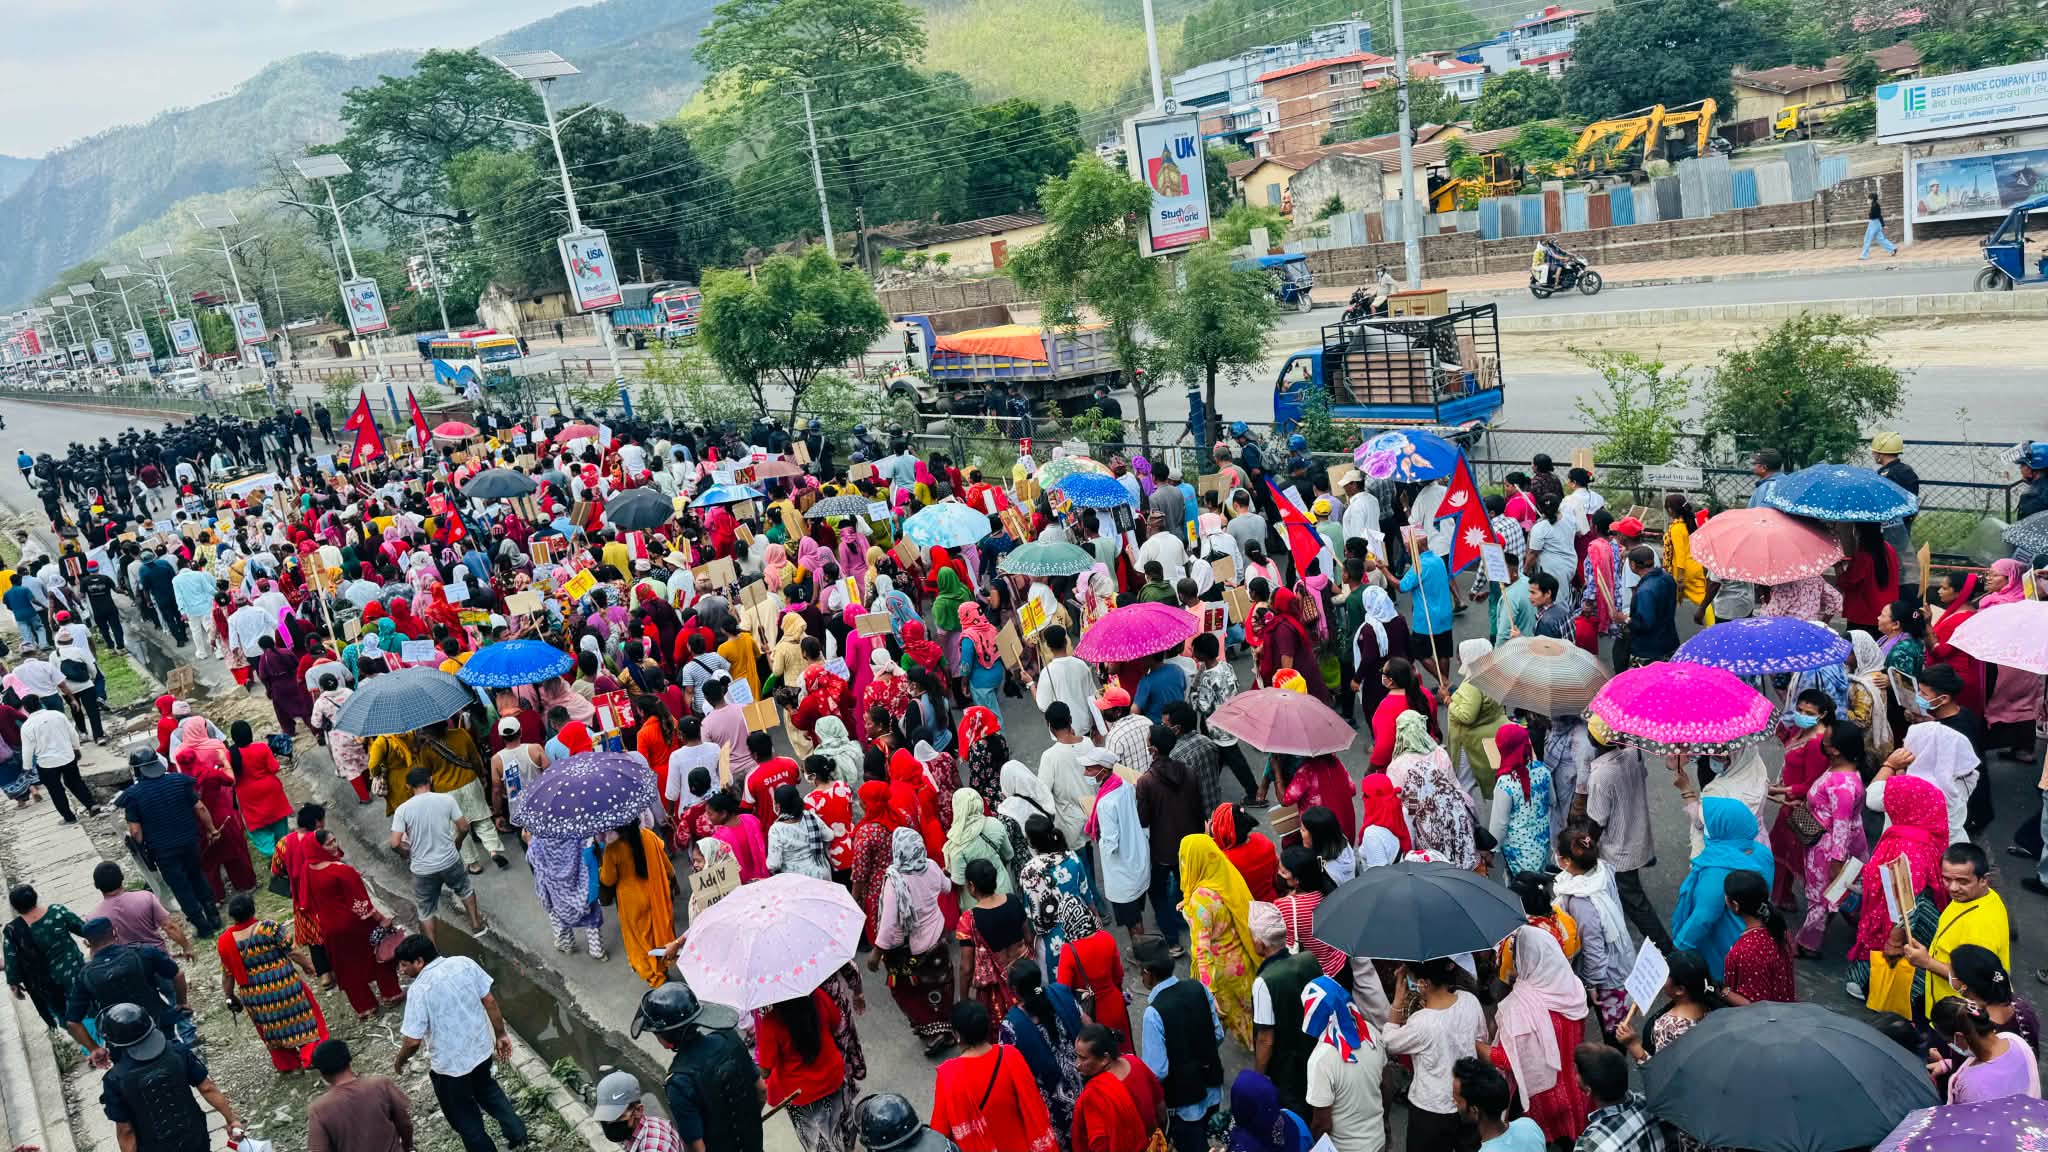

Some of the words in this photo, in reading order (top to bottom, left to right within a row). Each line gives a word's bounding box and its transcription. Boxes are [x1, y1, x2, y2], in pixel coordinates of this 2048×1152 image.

[1931, 87, 1951, 98] BEST
[1953, 81, 1988, 96] FINANCE
[1989, 74, 2030, 90] COMPANY
[1166, 101, 1176, 113] 28
[1175, 136, 1196, 159] UK
[1161, 208, 1185, 220] Study
[1178, 212, 1199, 223] World
[587, 248, 604, 260] USA
[763, 770, 789, 786] SIJAN
